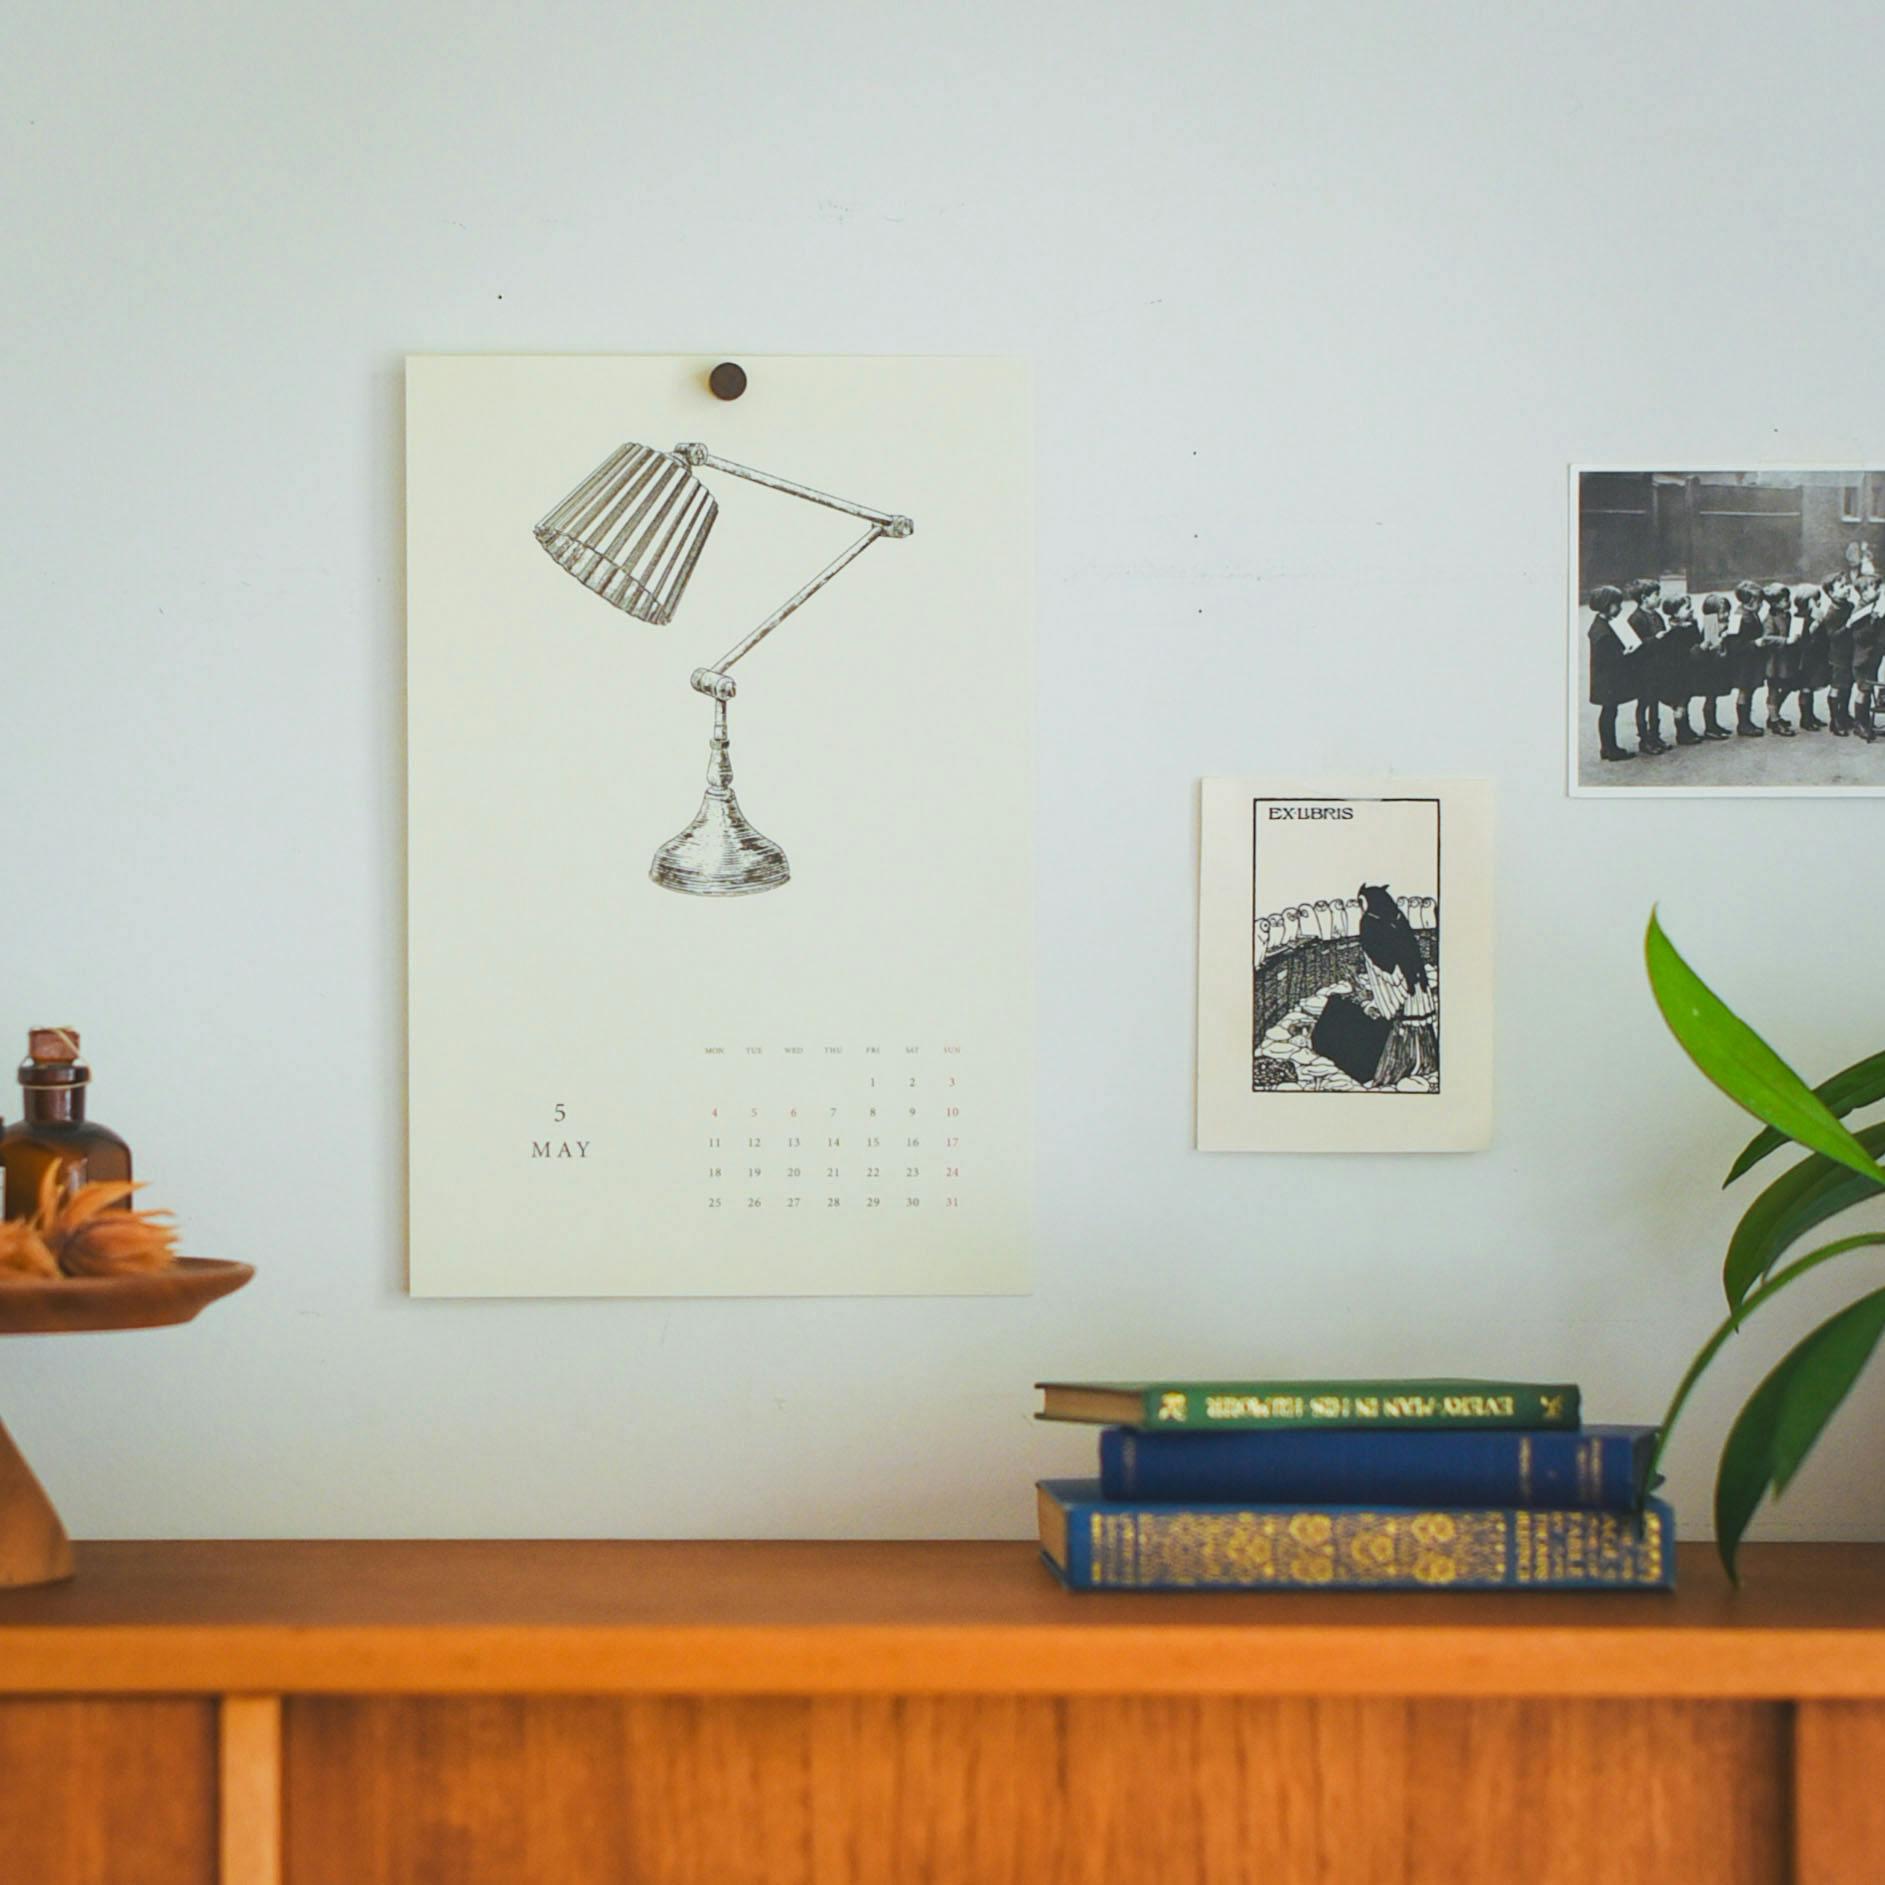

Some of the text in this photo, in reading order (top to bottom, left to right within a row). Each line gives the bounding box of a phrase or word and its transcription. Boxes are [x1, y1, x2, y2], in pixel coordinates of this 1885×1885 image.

[703, 1047, 724, 1055] MON
[746, 1047, 763, 1055] TUE
[784, 1047, 804, 1055] WED
[865, 1046, 880, 1054] FRI
[905, 1046, 919, 1054] SAT
[943, 1046, 961, 1054] SUN
[870, 1077, 956, 1088] 1 2 3
[553, 1103, 567, 1123] 5
[711, 1106, 960, 1118] 4 5 6 7 8 9 10
[709, 1136, 959, 1148] 11 12 13 14 15 16 17
[531, 1140, 591, 1159] MAY
[709, 1167, 959, 1179] 18 19 20 21 22 23 24
[708, 1196, 958, 1208] 25 26 27 28 29 30 31
